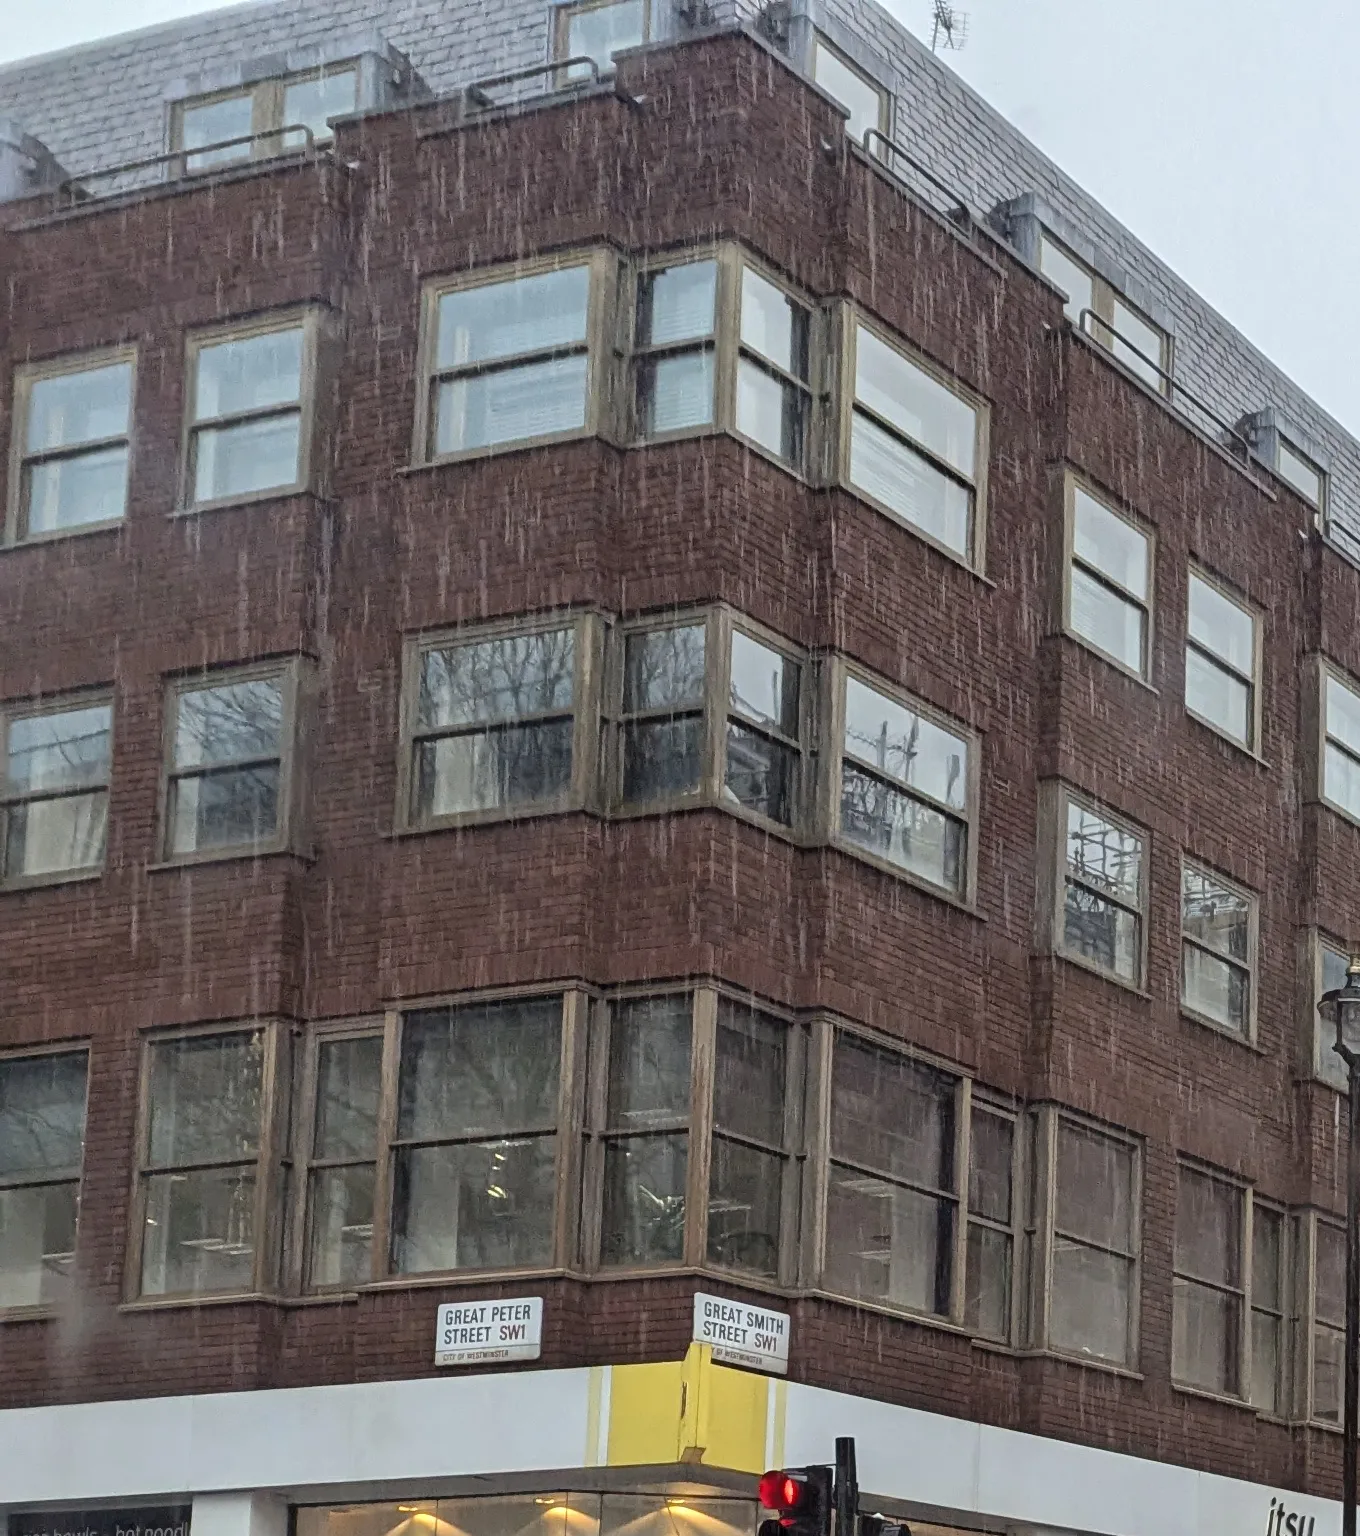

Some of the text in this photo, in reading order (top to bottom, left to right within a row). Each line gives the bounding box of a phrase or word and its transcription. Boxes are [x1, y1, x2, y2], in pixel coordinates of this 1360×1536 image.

[445, 1304, 531, 1326] GREAT PETER
[704, 1301, 784, 1335] GREAT SMITH
[443, 1324, 526, 1345] STREET SW1
[702, 1320, 777, 1353] STREET SW1
[442, 1349, 509, 1362] CITY OF WESTMINSTER
